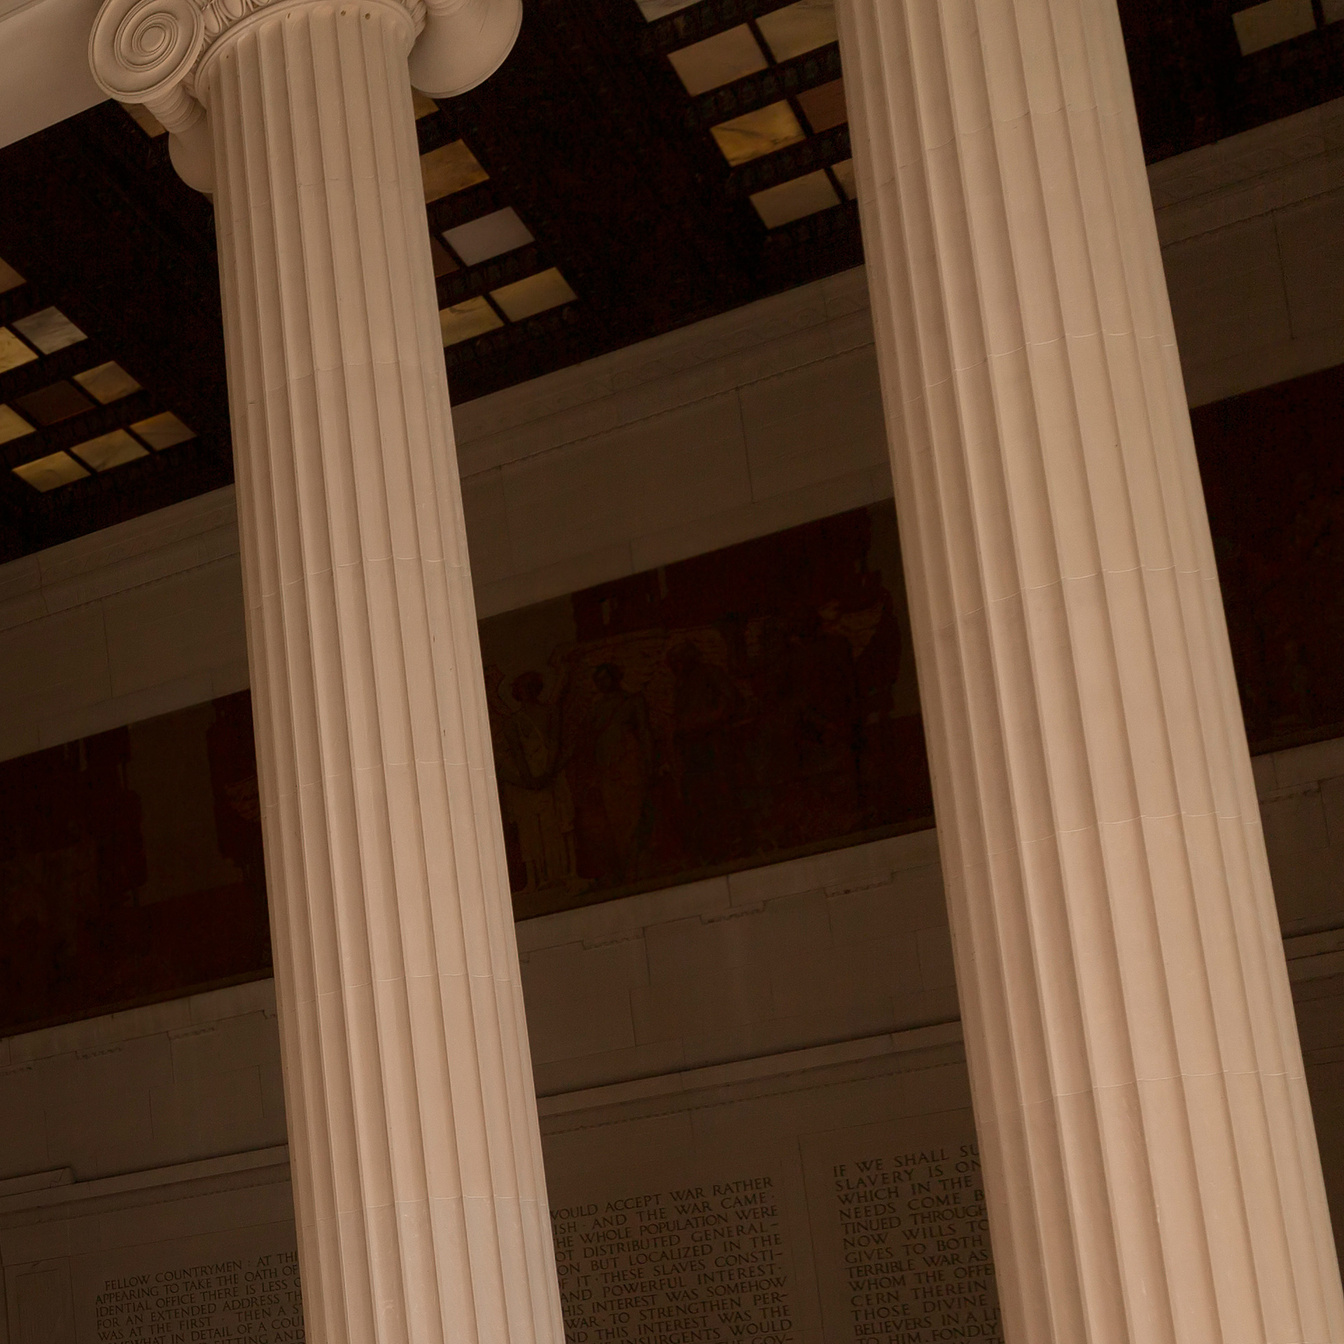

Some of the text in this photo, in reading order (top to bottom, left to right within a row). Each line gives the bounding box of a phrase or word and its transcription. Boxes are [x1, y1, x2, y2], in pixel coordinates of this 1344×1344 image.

[833, 1148, 949, 1177] IF WE SHALL
[605, 1176, 773, 1212] ACCEPT WAR RATHER
[839, 1192, 960, 1221] NEEDS COME
[579, 1205, 778, 1243] WHOLE POPULATION WERE
[591, 1233, 782, 1271] BUT LOCALIZED IN THE
[844, 1235, 983, 1263] GIVES TO BOTH
[95, 1286, 158, 1304] APPEARING
[163, 1283, 179, 1294] TO
[182, 1278, 211, 1291] TAKE
[216, 1273, 238, 1286] THE
[244, 1268, 277, 1282] OATH
[592, 1276, 787, 1313] INTEREST WAS SOMEHOW
[848, 1270, 945, 1291] WHOM THE
[97, 1294, 280, 1328] FOR AN EXTENDED ADDRESS
[594, 1305, 790, 1340] THIS INTEREST WAS THE
